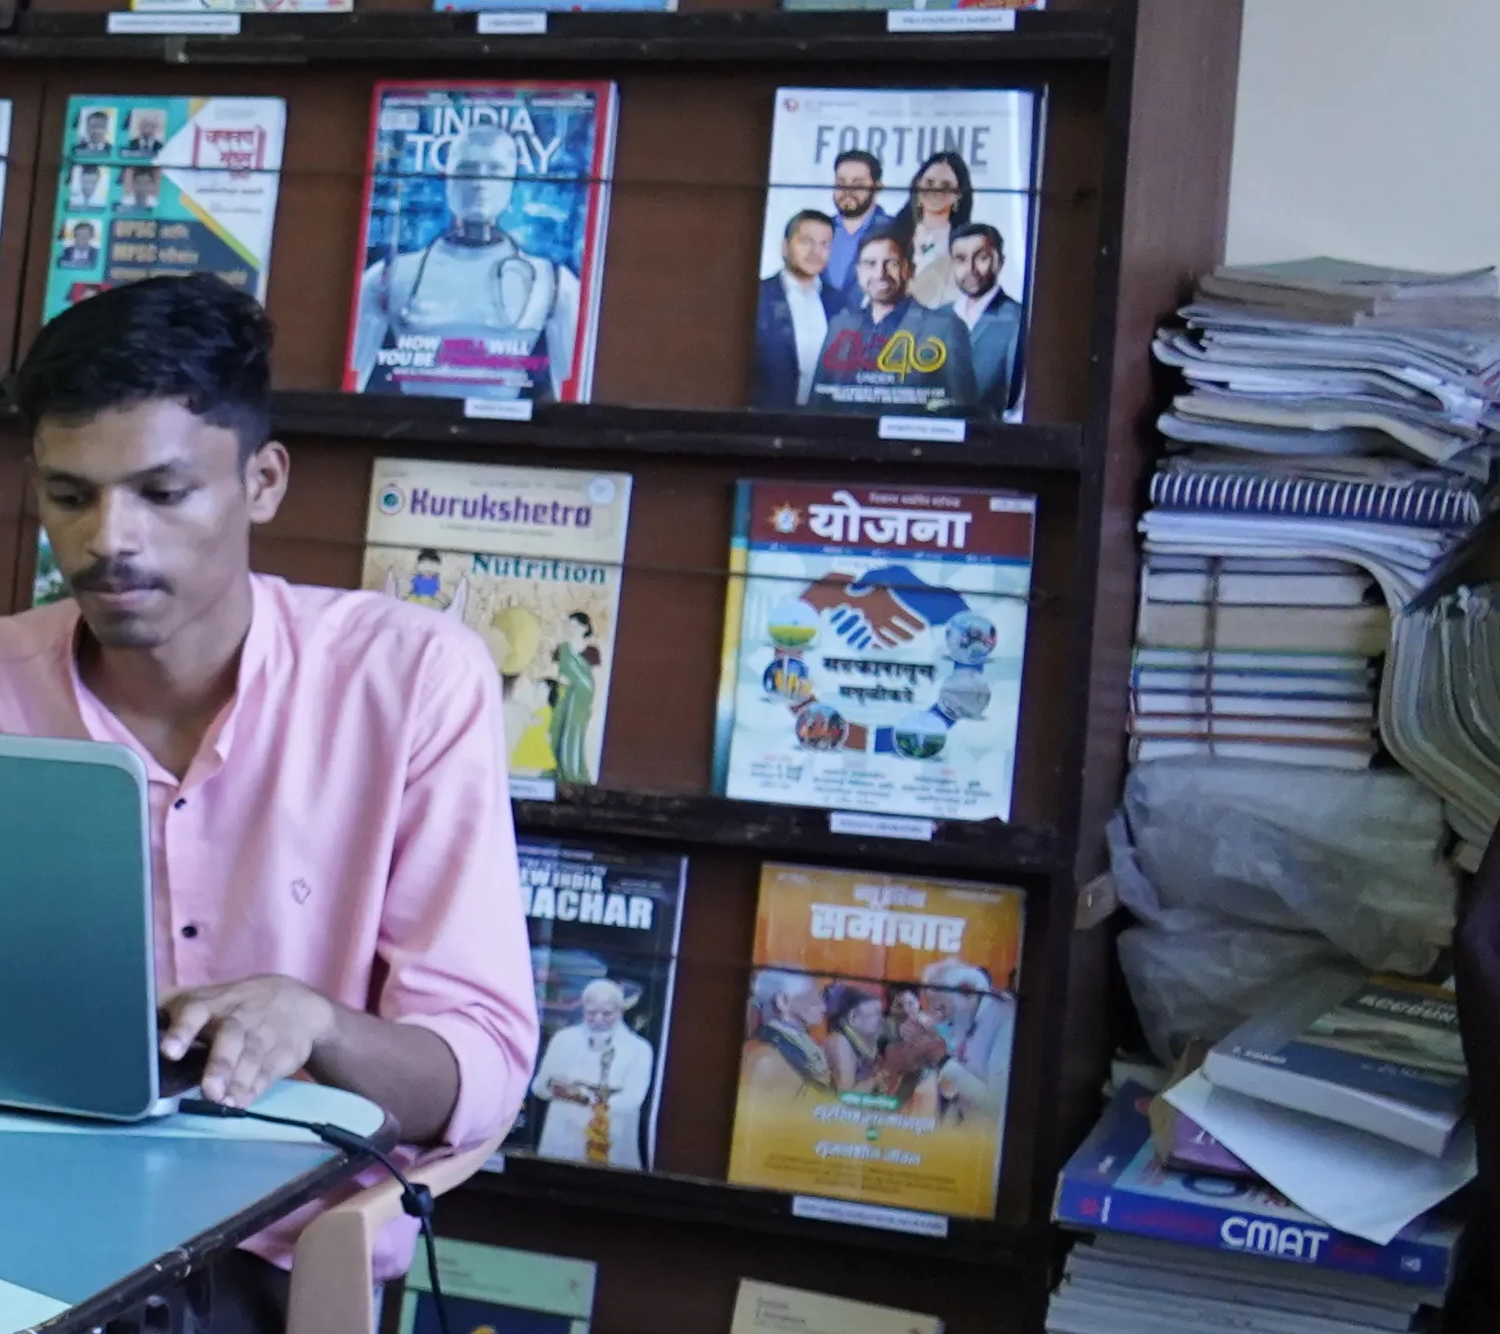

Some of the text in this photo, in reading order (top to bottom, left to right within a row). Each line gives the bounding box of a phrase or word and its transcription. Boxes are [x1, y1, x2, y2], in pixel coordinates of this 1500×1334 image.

[433, 107, 536, 136] INDIA
[406, 134, 561, 174] TOAY
[814, 124, 991, 167] FORTUNE
[410, 488, 593, 528] Kurukshetra
[808, 490, 972, 549] योजना
[471, 552, 607, 584] Nutrition
[526, 887, 653, 931] ACHAR
[811, 902, 967, 953] समाचार
[1221, 1216, 1329, 1263] CMAT
